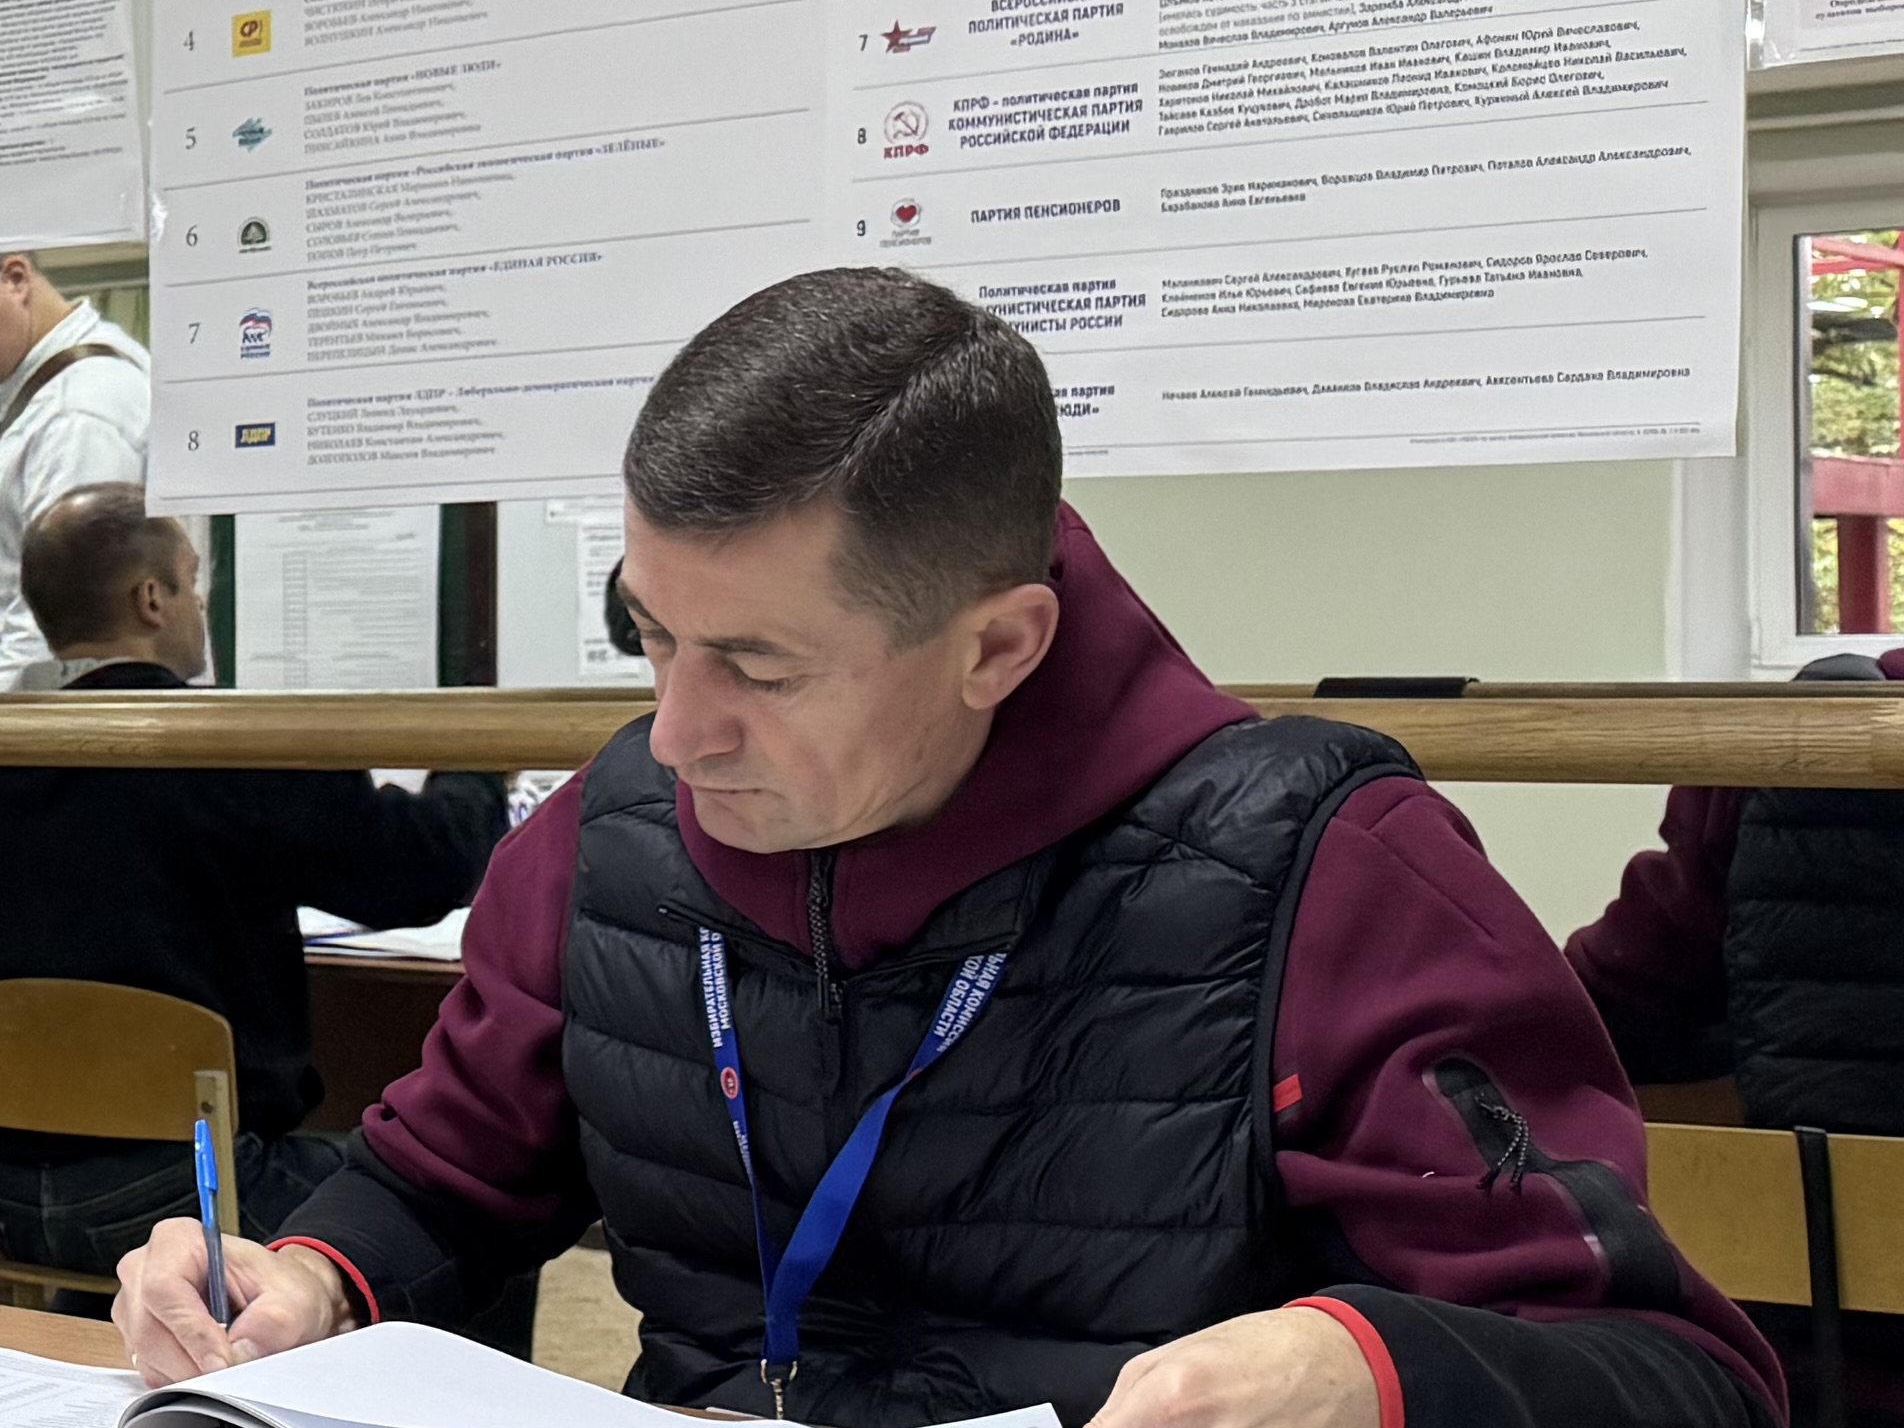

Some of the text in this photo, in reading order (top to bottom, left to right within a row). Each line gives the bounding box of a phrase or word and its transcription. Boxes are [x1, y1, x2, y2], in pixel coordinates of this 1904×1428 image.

[968, 1, 1124, 34] ПОЛИТИЧЕСКАЯ ПАРТИЯ
[182, 29, 195, 52] 4
[858, 33, 869, 52] 7
[1009, 27, 1080, 47] «РОДИНА»
[952, 82, 1139, 113] КПРФ политическая партия
[947, 98, 1144, 131] КОММУНИСТИЧЕСКАЯ ПАРТИЯ
[184, 126, 197, 151] 5
[856, 126, 867, 145] 8
[959, 118, 1130, 149] РОССИЙСКОЙ ФЕДЕРАЦИИ
[883, 143, 929, 159] КПРФ
[970, 198, 1121, 223] ПАРТИЯ ПЕНСИОНЕРОВ
[184, 224, 199, 247] 6
[856, 219, 866, 237] 9
[978, 278, 1117, 299] Политическая партия
[986, 292, 1146, 319] УНИСТИЧЕСКАЯ ПАРТИЯ
[187, 321, 201, 345] 7
[1010, 313, 1123, 333] УНИСТЫ РОССИИ
[1058, 403, 1099, 418] ЮДИ»
[187, 429, 200, 452] 8
[700, 940, 723, 1048] ИЗБИРАТЕЛЬНАЯ
[711, 943, 731, 1030] МОСКОВСКОЙ
[933, 979, 970, 1038] ОБЛАСТИ
